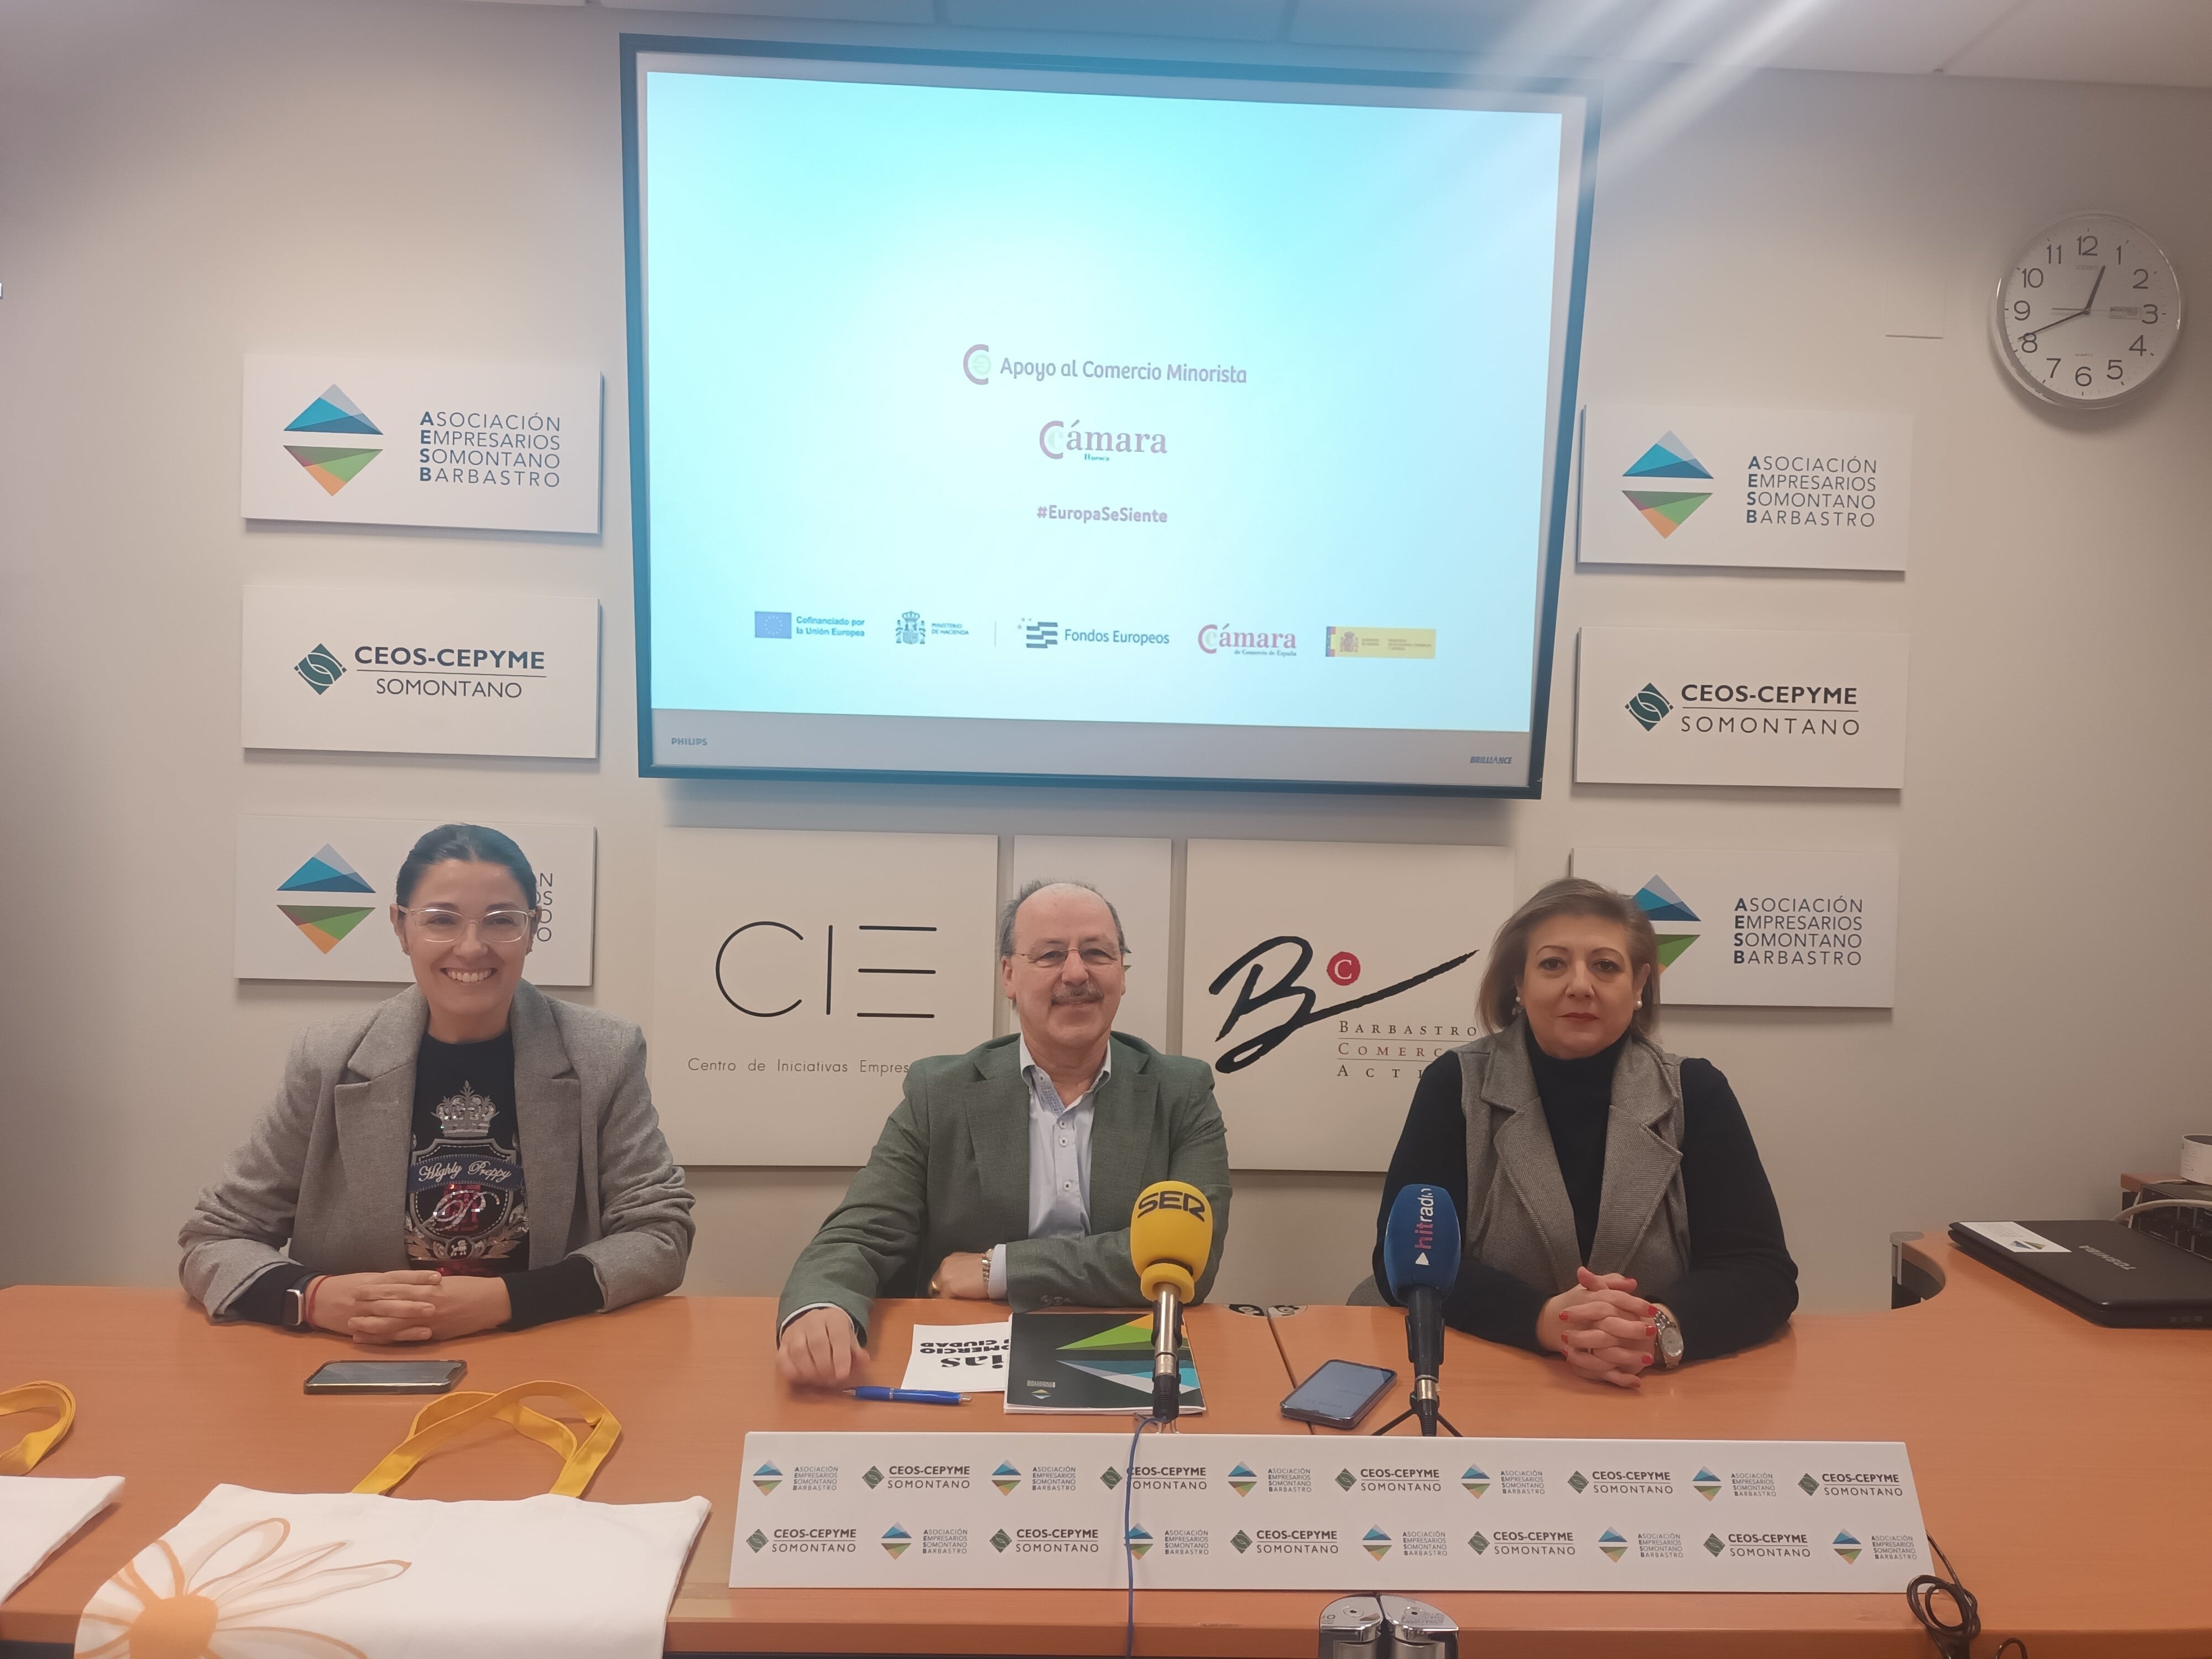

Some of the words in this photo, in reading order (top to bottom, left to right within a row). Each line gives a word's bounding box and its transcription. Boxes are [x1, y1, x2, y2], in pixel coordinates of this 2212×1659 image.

[2047, 244, 2062, 264] 11
[2077, 236, 2098, 256] 12
[2116, 245, 2121, 264] 1
[2021, 268, 2043, 288] 10
[2133, 269, 2148, 289] 2
[2013, 300, 2031, 320] 9
[2142, 304, 2158, 324] 3
[2021, 333, 2038, 353] 8
[2128, 335, 2147, 356] 4
[1000, 358, 1056, 381] Apoyo
[1060, 360, 1078, 377] al
[1082, 361, 1162, 380] Comercio
[1167, 363, 1247, 383] Minorista
[2046, 358, 2061, 378] 7
[2075, 367, 2092, 387] 6
[2106, 359, 2123, 379] 5
[420, 411, 560, 432] ASOCIACIÓN
[421, 430, 560, 450] EMPRESARIOS
[1039, 419, 1167, 459] Cámara
[420, 448, 560, 469] SOMONTANO
[1747, 456, 1876, 474] ASOCIACIÓN
[420, 467, 560, 487] BARBASTRO
[1748, 474, 1876, 492] EMPRESARIOS
[1747, 492, 1876, 509] SOMONTANO
[1037, 505, 1167, 523] #EuropaSeSiente
[1746, 510, 1875, 527] BARBASTRO
[796, 616, 849, 625] Cofinanciado
[832, 628, 865, 638] Europea
[1064, 629, 1108, 643] Fondos
[1113, 631, 1170, 646] Europeos
[1198, 623, 1296, 654] Cámara
[354, 646, 545, 670] CEOS-CEPYME
[375, 679, 522, 698] SOMONTANO
[1681, 684, 1857, 705] CEOS-CEPYME
[1681, 716, 1860, 735] SOMONTANO
[1734, 895, 1863, 913] ASOCIACIÓN
[1735, 915, 1863, 931] EMPRESARIOS
[1734, 933, 1862, 948] SOMONTANO
[1734, 950, 1861, 966] BARBASTRO
[716, 921, 937, 1018] CIE
[1339, 1021, 1477, 1036] BARBASTRO
[687, 1058, 736, 1072] Centro
[748, 1058, 765, 1072] de
[778, 1059, 848, 1072] Iniciativas
[419, 1162, 462, 1182] Highly
[468, 1161, 512, 1182] Preppy
[1138, 1191, 1205, 1222] SER
[2079, 1245, 2136, 1270] TOSHIBA
[889, 1465, 971, 1475] CEOS-CEPYME
[1360, 1469, 1439, 1478] CEOS-CEPYME
[1592, 1471, 1671, 1480] CEOS-CEPYME
[1822, 1474, 1900, 1483] CEOS-CEPYME
[888, 1480, 970, 1489] SOMONTANO
[1133, 1481, 1207, 1489] OMONTANO
[1361, 1483, 1441, 1491] SOMONTANO
[1593, 1485, 1673, 1494] SOMONTANO
[1824, 1487, 1903, 1496] SOMONTANO
[774, 1529, 857, 1538] CEOS-CEPYME
[1016, 1529, 1098, 1538] CEOS-CEPYME
[1256, 1530, 1337, 1540] CEOS-CEPYME
[1493, 1531, 1573, 1541] CEOS-CEPYME
[1728, 1534, 1808, 1543] CEOS-CEPYME
[772, 1543, 856, 1552] SOMONTANO
[1016, 1543, 1099, 1553] SOMONTANO
[1256, 1545, 1339, 1554] SOMONTANO
[1494, 1546, 1575, 1556] SOMONTANO
[1730, 1548, 1811, 1557] SOMONTANO
